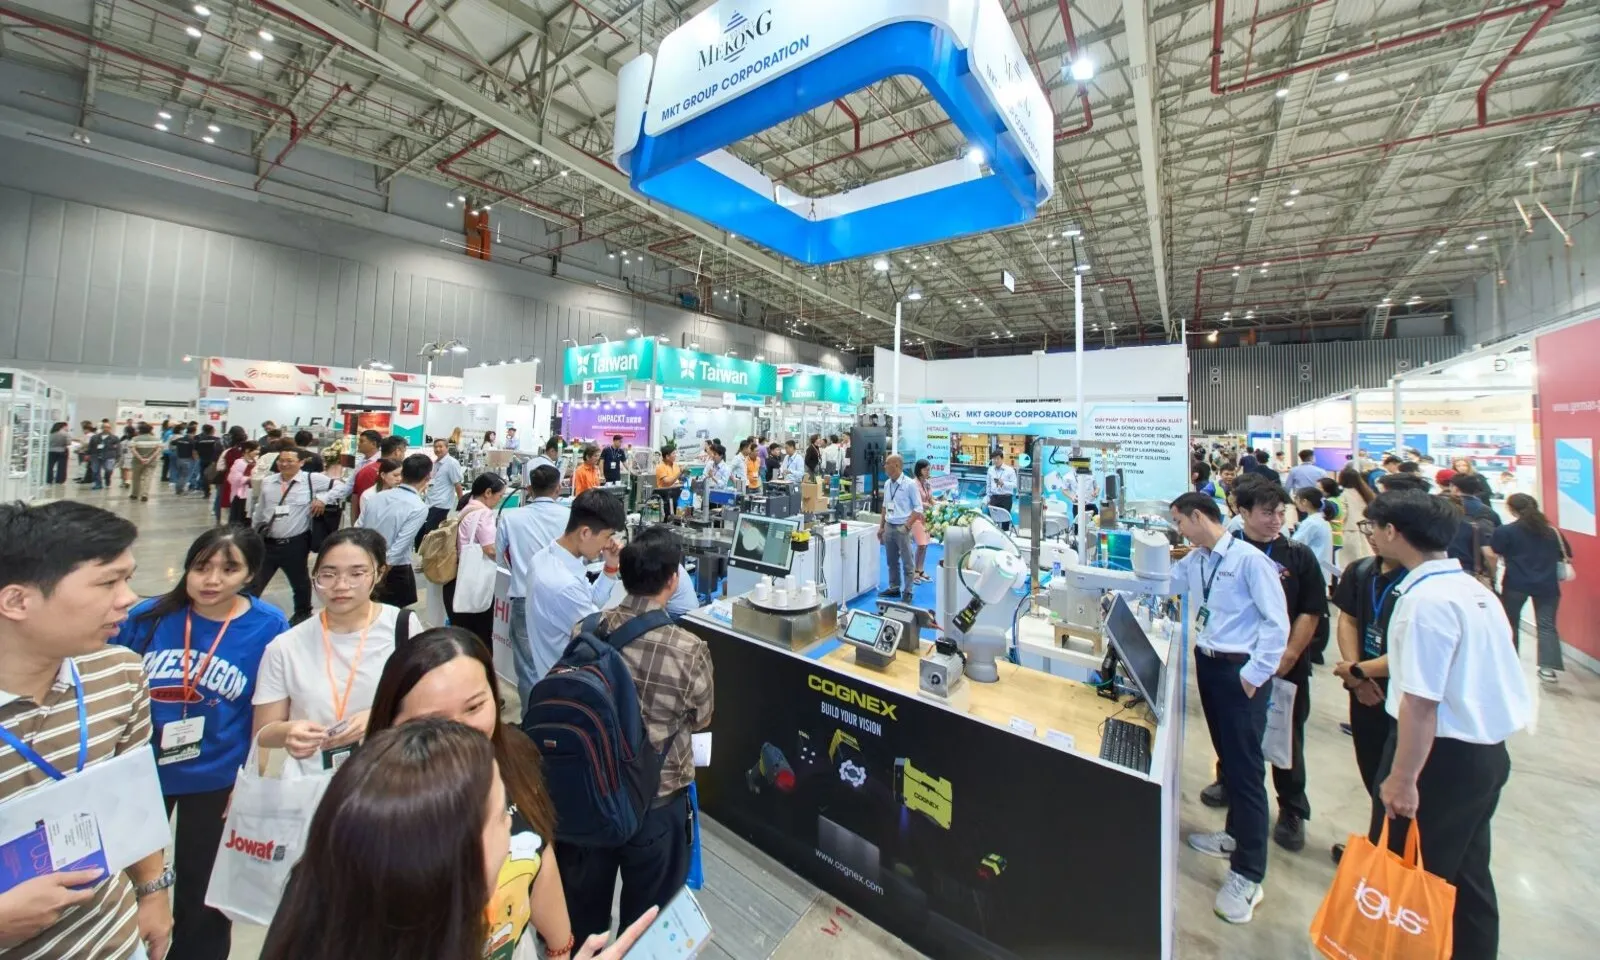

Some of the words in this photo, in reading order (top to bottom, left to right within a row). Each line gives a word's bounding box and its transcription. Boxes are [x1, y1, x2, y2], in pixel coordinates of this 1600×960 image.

[698, 9, 773, 71] MEKONG
[661, 103, 681, 121] MKT
[682, 84, 718, 111] GROUP
[721, 34, 810, 91] CORPORATION
[591, 352, 638, 374] Taiwan
[700, 361, 748, 386] Taiwan
[791, 389, 815, 398] Taiwan
[966, 410, 982, 418] MKT
[984, 410, 1012, 418] GROUP
[1014, 410, 1077, 418] CORPORATION
[807, 674, 898, 721] COGNEX
[821, 701, 840, 719] BUILD
[840, 709, 858, 728] YOUR
[858, 716, 882, 737] VISION
[914, 792, 939, 810] COGNEX
[225, 829, 274, 861] Jowat
[815, 848, 884, 896] www.cognex.com
[1353, 877, 1426, 935] igus
